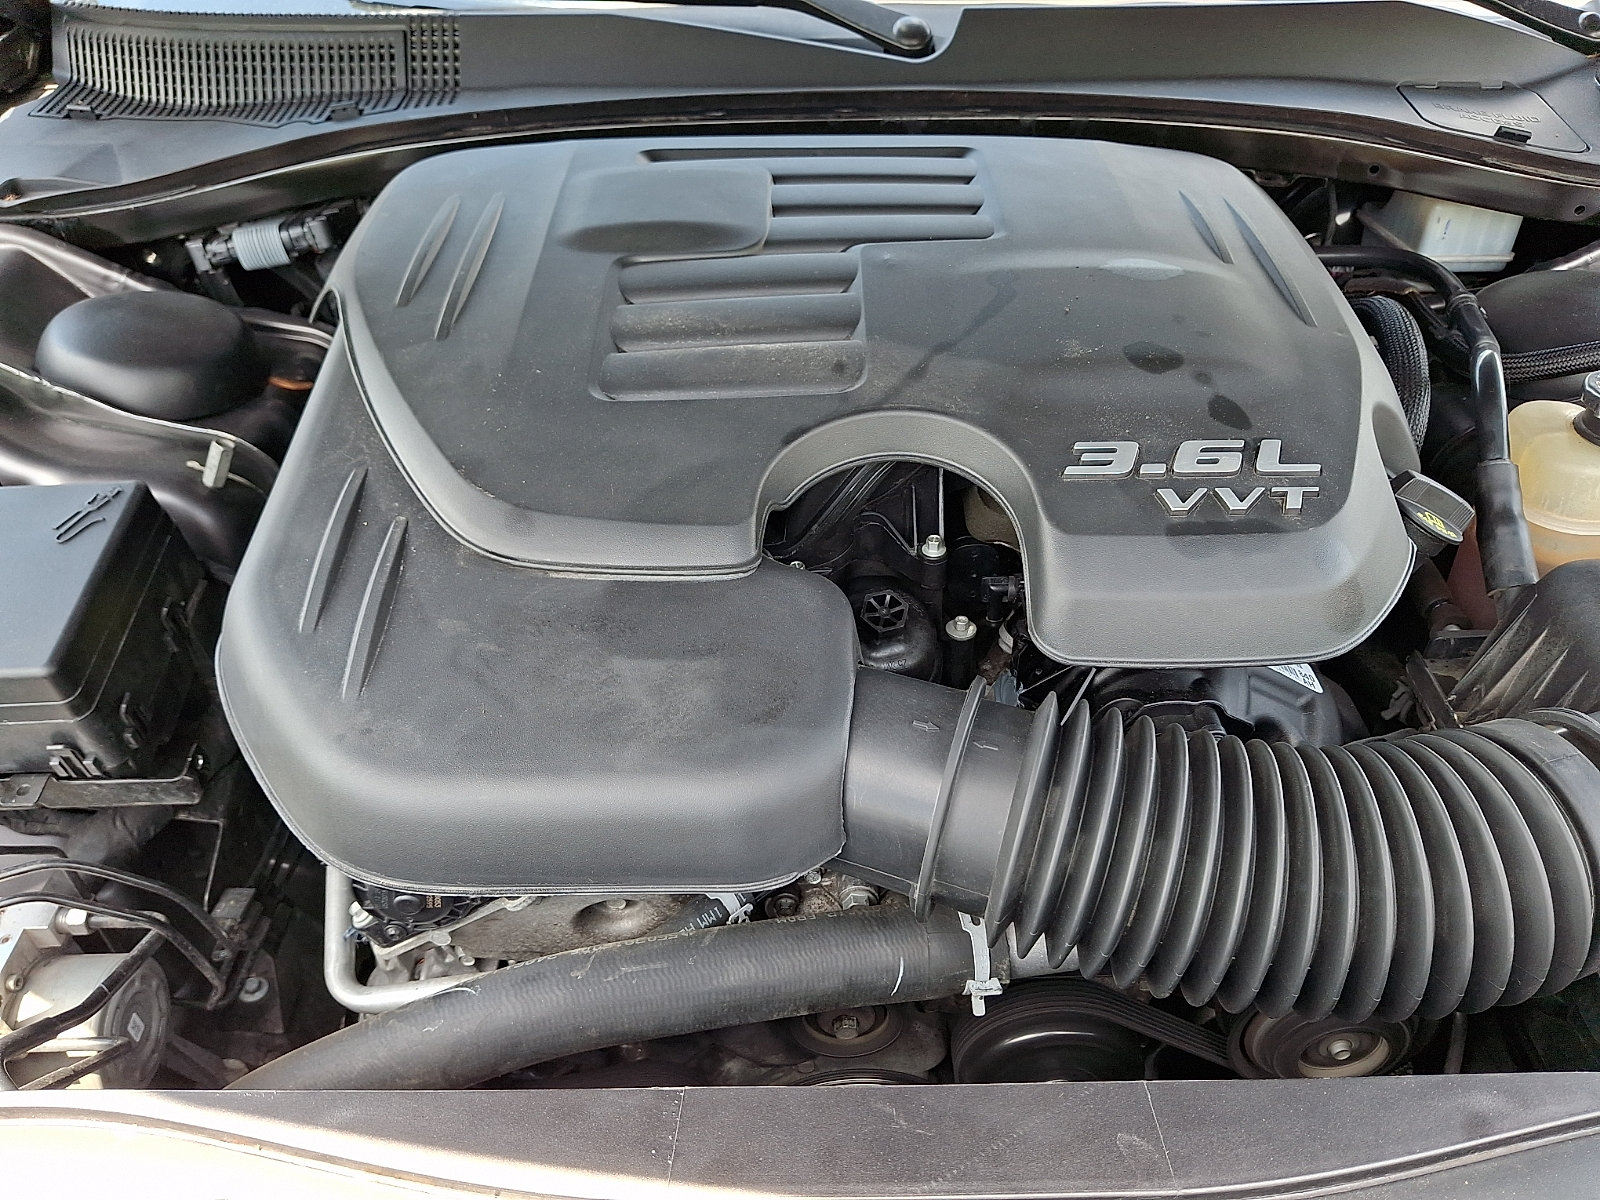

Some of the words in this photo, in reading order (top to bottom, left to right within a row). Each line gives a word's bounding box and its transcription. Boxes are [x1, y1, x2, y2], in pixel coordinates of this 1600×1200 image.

[1459, 113, 1525, 128] ACCESS
[1491, 112, 1541, 123] FLUID
[1061, 439, 1322, 480] 3.6L
[1154, 486, 1320, 516] VVT
